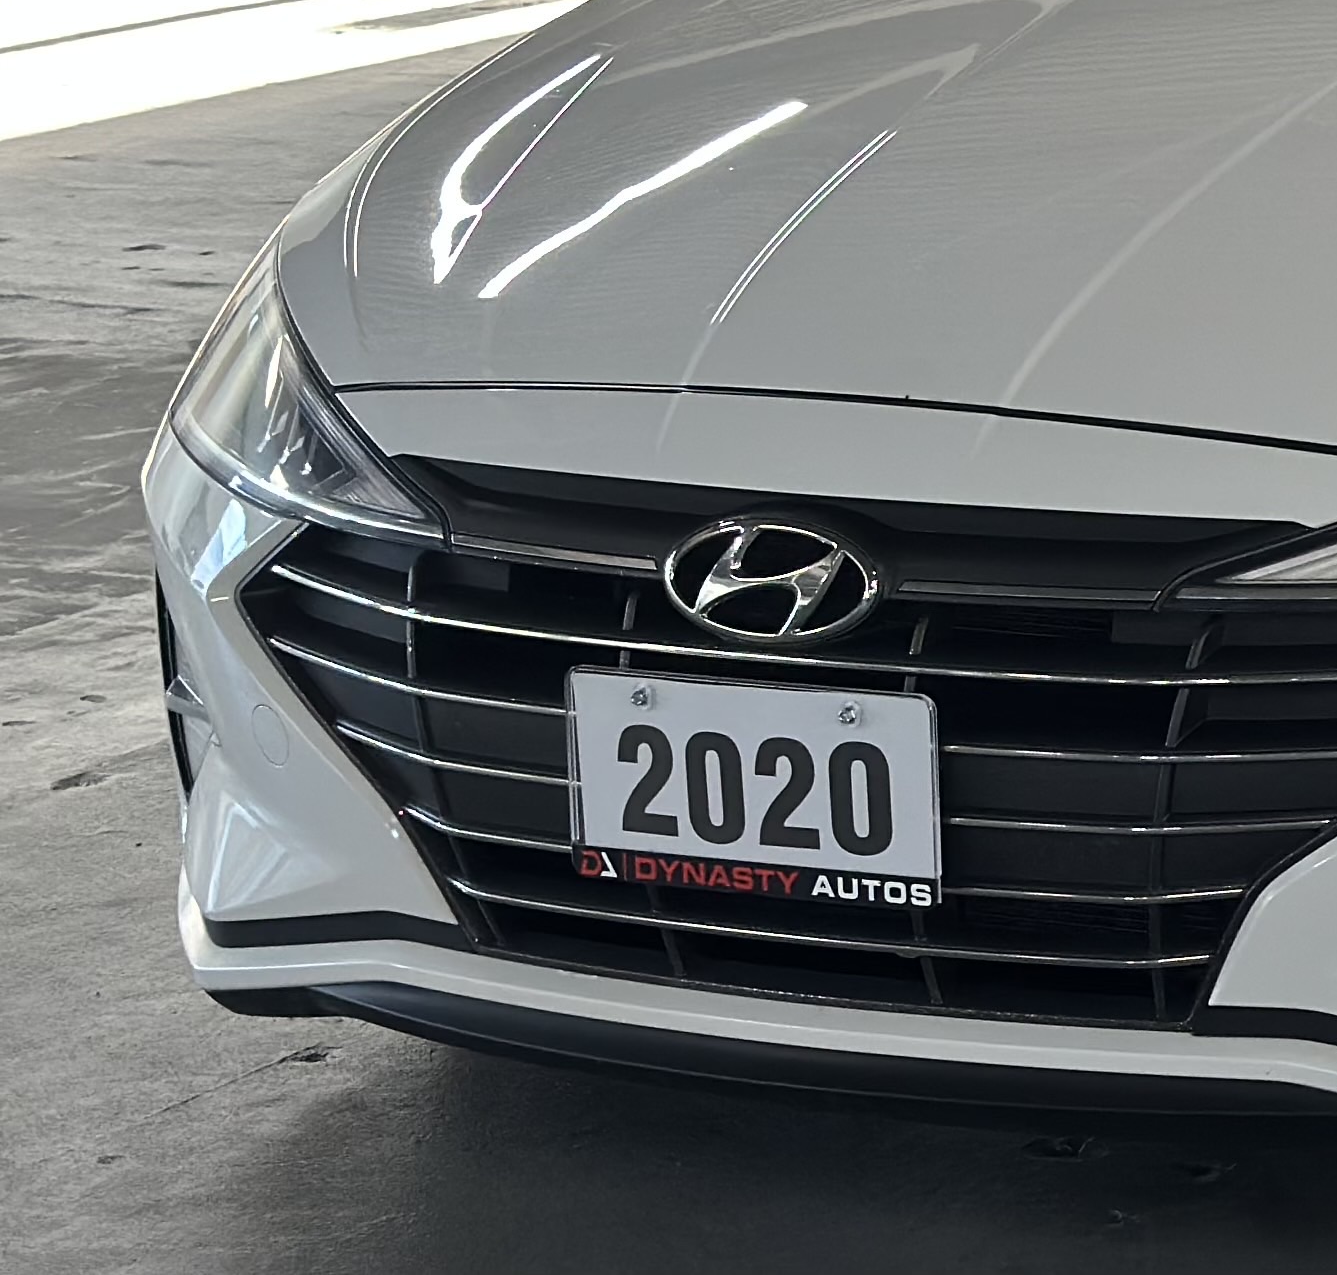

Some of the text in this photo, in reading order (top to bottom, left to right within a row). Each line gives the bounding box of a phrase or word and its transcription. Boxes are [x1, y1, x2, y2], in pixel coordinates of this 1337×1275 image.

[617, 724, 894, 857] 2020
[634, 857, 799, 895] DYNASTY
[811, 874, 932, 908] AUTOS
